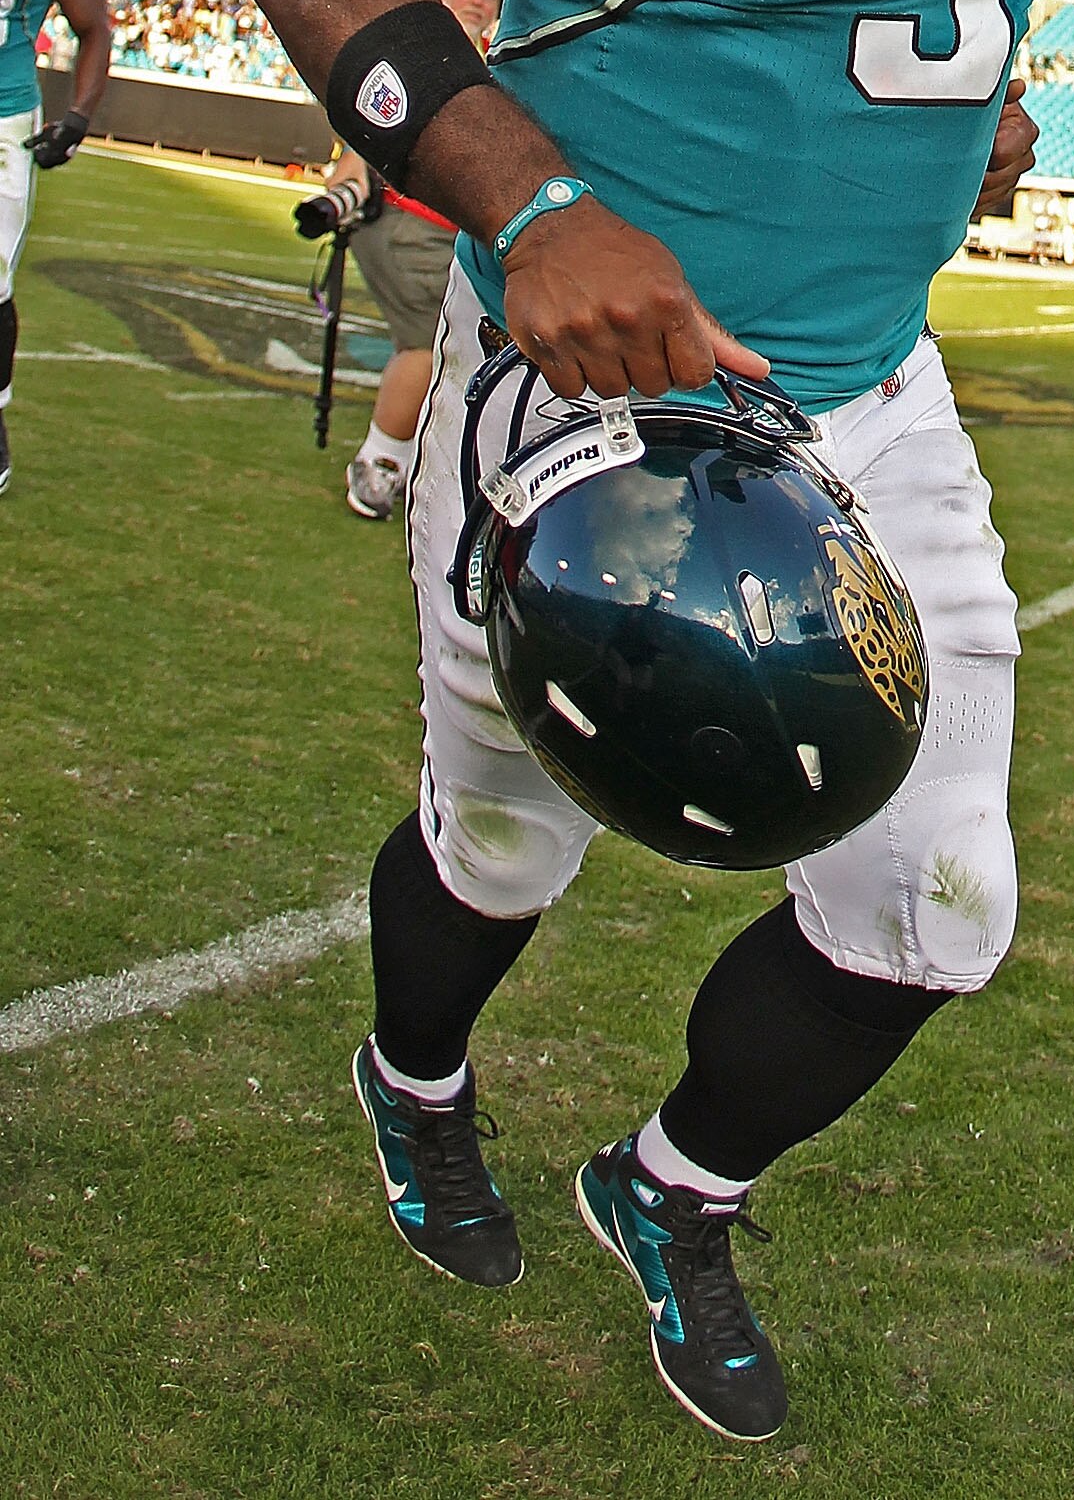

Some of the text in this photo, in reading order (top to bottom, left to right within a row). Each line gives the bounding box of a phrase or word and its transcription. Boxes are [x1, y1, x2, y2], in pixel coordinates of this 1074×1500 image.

[361, 68, 388, 113] EQUIPMENT
[380, 96, 400, 119] NFL
[882, 376, 899, 394] NFL
[529, 444, 600, 498] Riddell
